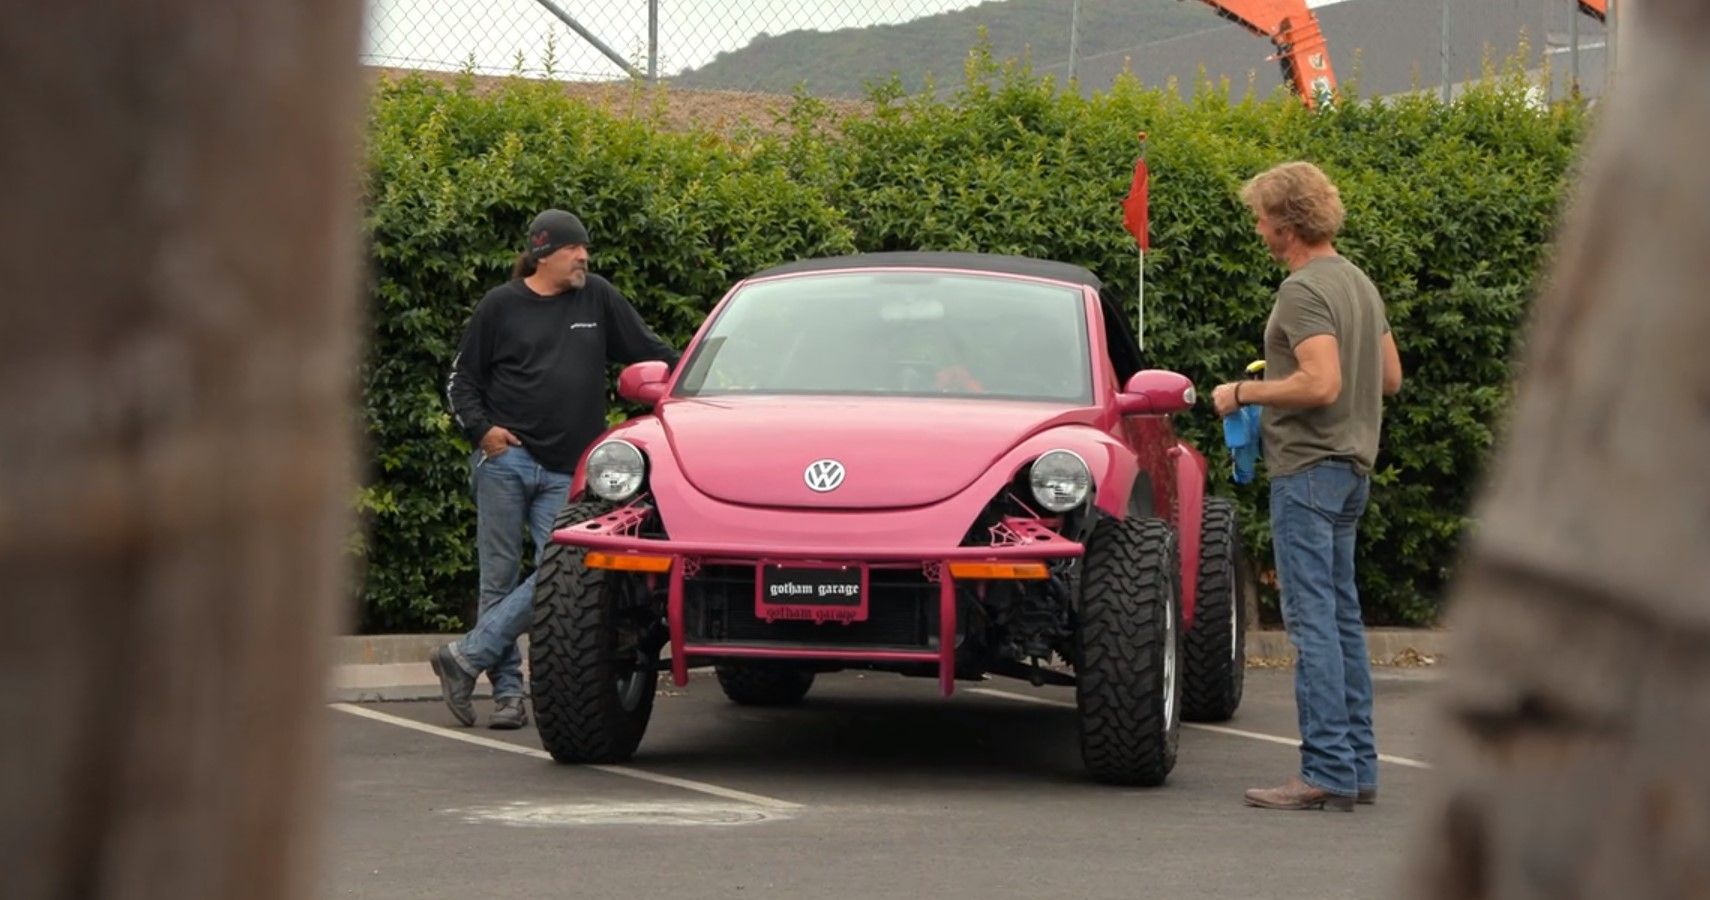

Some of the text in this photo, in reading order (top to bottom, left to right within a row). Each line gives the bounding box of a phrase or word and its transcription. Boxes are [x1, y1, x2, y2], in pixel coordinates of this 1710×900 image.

[804, 459, 846, 492] VW
[769, 582, 860, 596] gotham garage
